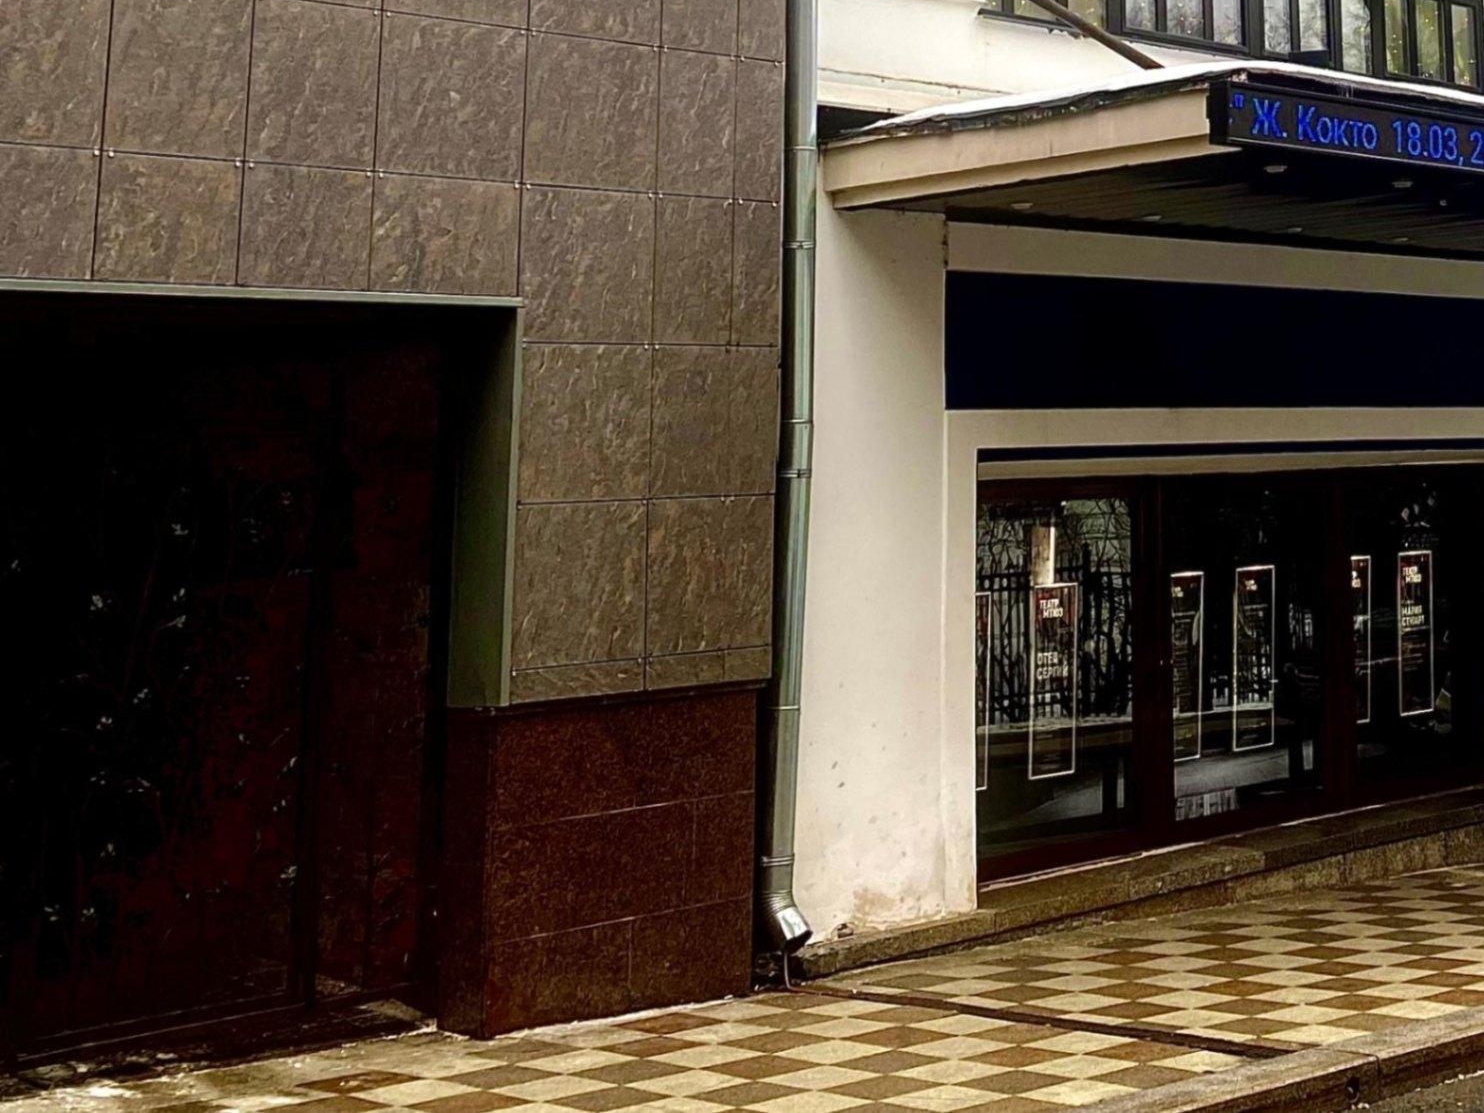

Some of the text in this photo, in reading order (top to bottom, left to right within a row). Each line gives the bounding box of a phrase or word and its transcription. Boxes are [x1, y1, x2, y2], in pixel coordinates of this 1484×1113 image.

[1252, 98, 1287, 137] Ж.
[1297, 105, 1378, 150] Кокто
[1392, 120, 1464, 167] 18.03,
[1039, 598, 1060, 610] ТЕАТР
[1036, 652, 1058, 666] ОТЕЦ
